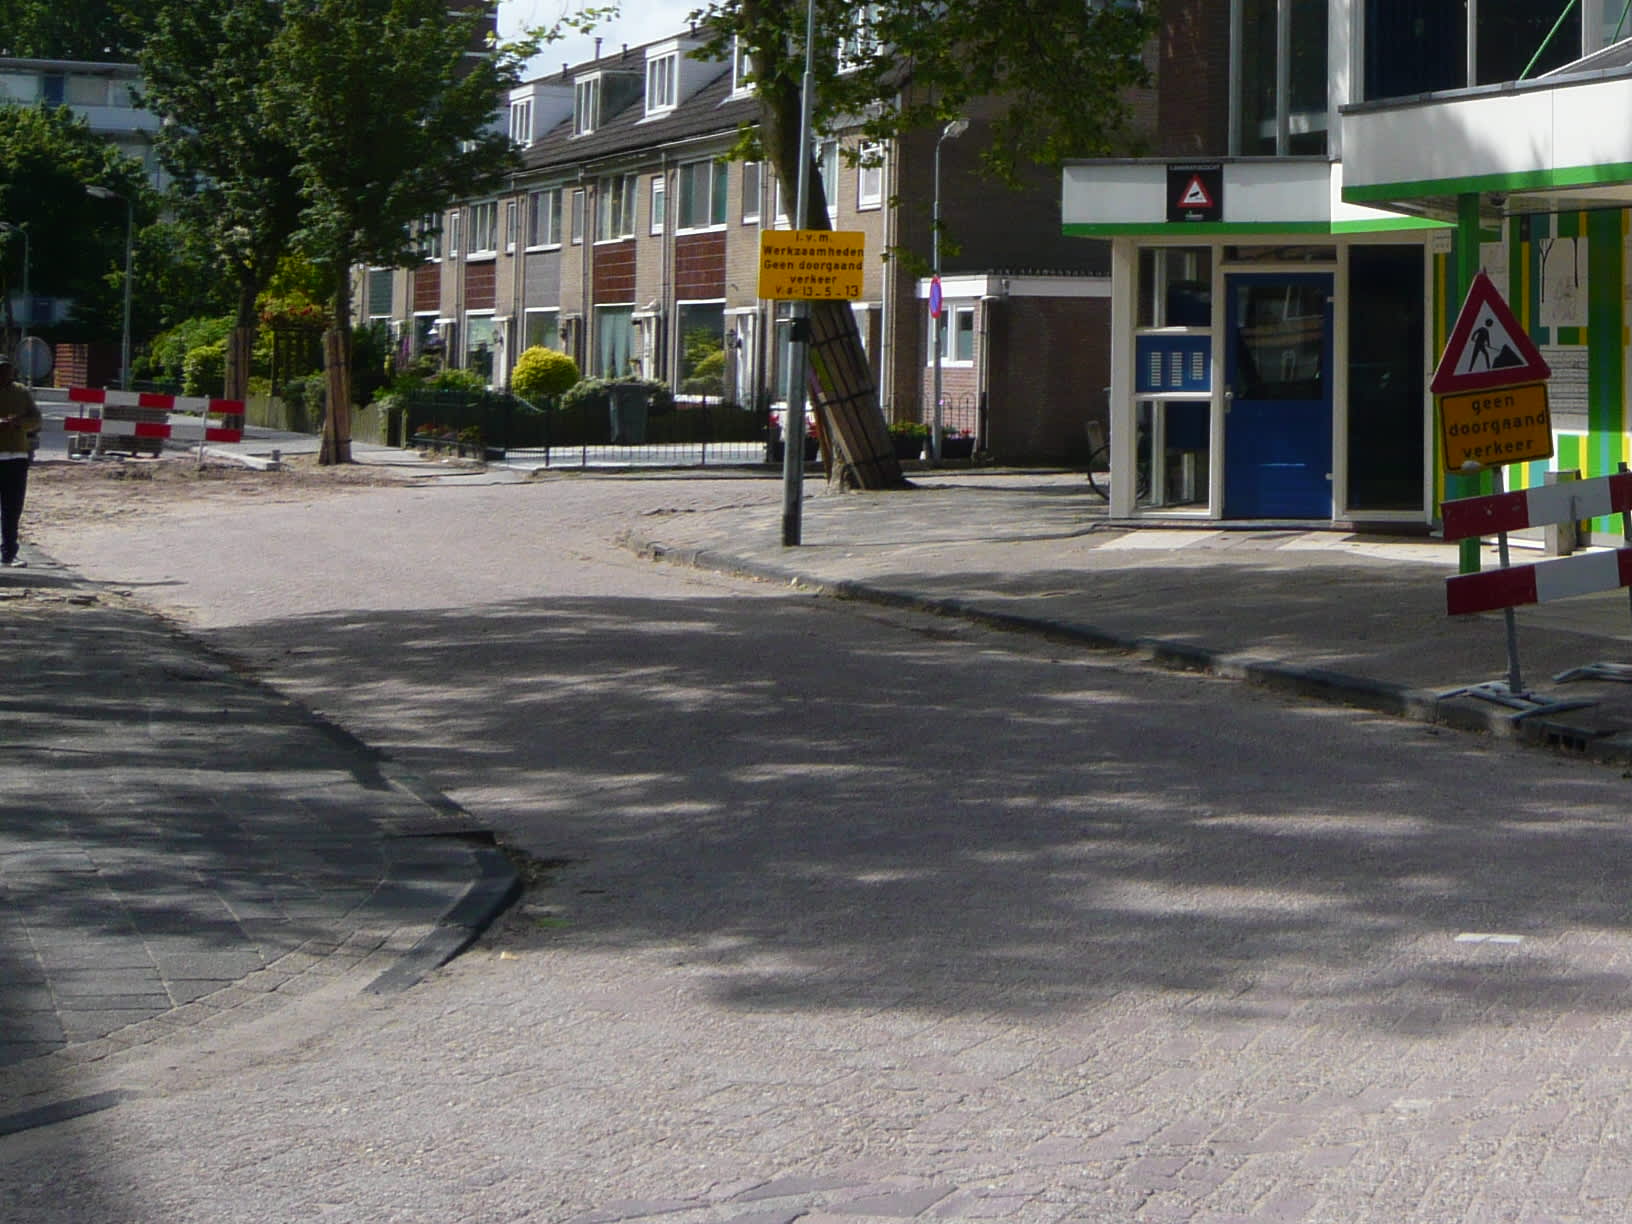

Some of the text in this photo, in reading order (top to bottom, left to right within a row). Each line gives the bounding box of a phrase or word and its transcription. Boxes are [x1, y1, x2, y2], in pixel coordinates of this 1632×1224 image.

[763, 245, 864, 257] Werkzaamheden
[764, 260, 863, 272] Geen doorgaand
[790, 275, 837, 285] verkeer
[1471, 396, 1514, 415] geen
[1449, 410, 1546, 437] doorgaand
[1463, 439, 1534, 458] verkeer
